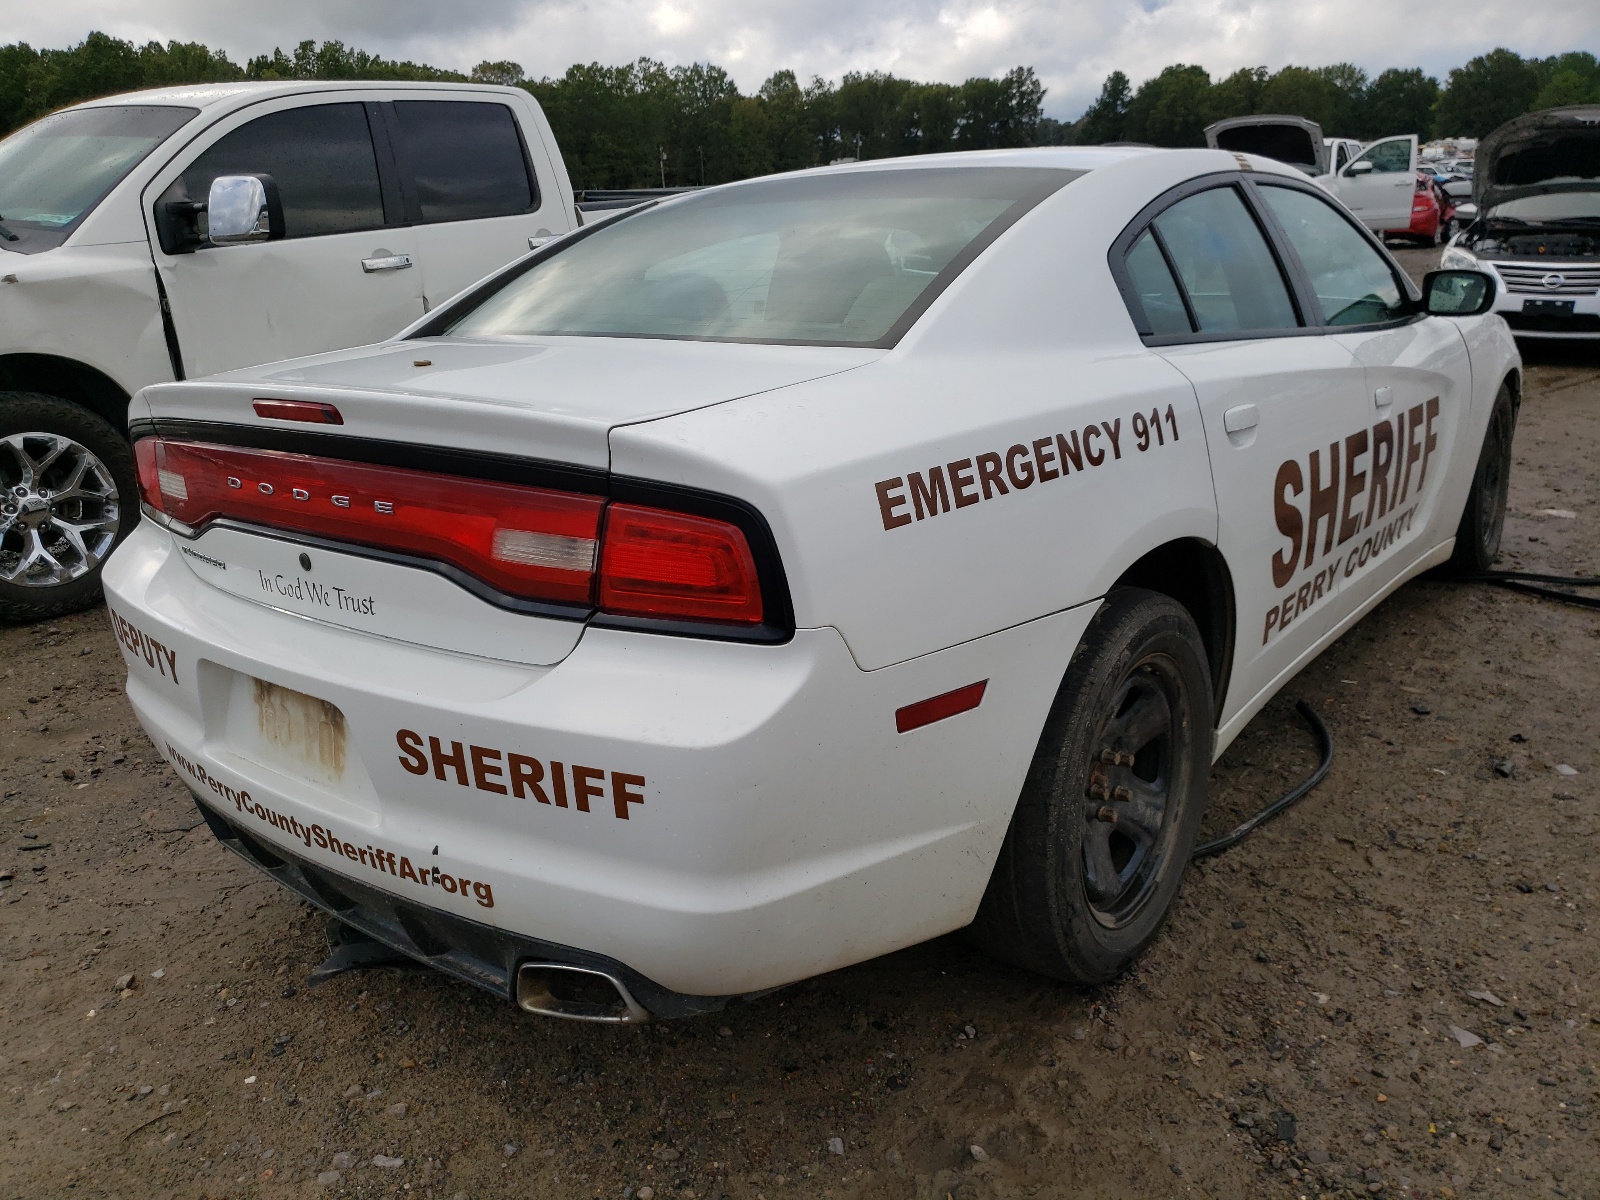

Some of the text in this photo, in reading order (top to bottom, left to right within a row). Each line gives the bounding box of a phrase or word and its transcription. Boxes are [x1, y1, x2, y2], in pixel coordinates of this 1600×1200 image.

[227, 476, 393, 514] DODGE
[875, 404, 1179, 531] EMERGENCY 911
[1272, 396, 1439, 588] SHERIFF
[259, 570, 376, 615] In God We Trust
[1262, 502, 1419, 646] PERRY COUNTY
[111, 607, 179, 685] DEPUTY
[165, 741, 494, 908] www.PerryCountySheriffArorg
[396, 728, 646, 820] SHERIFF
